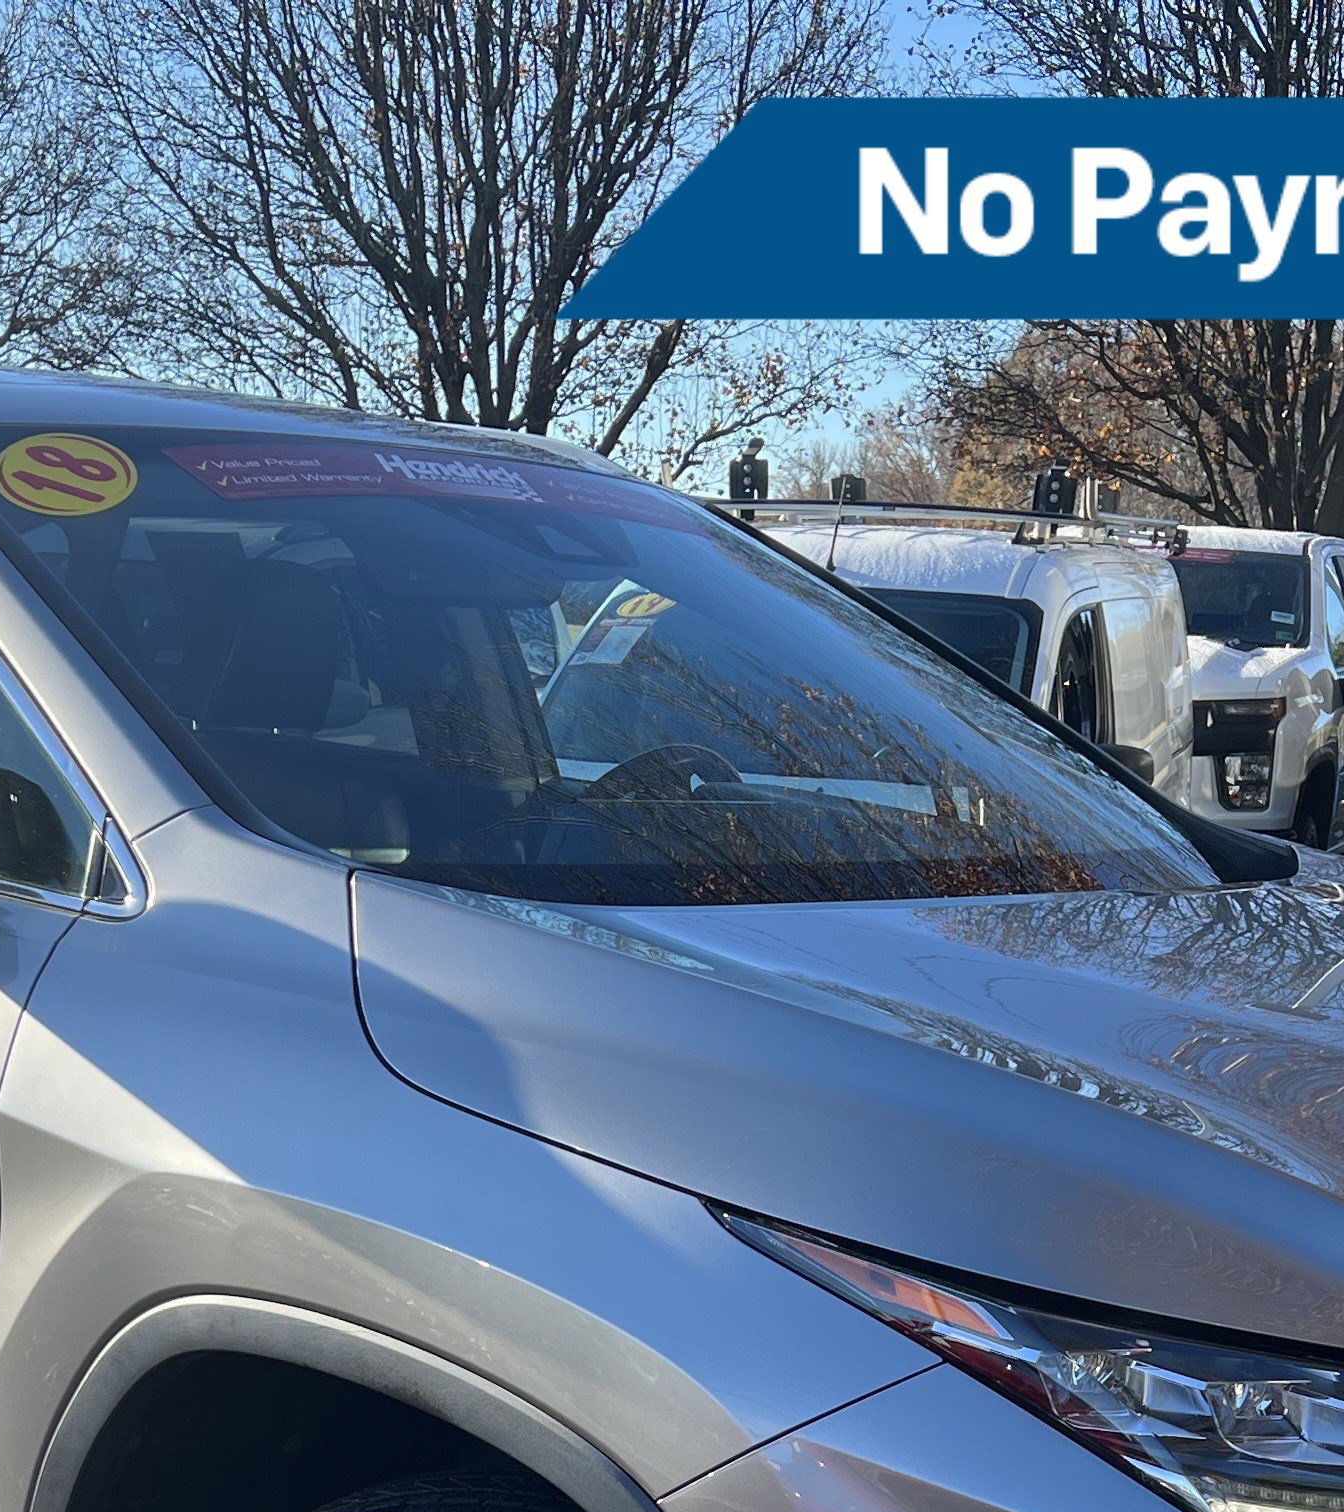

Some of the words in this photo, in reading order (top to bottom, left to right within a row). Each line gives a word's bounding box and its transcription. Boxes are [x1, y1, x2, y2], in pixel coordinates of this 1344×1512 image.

[11, 444, 118, 504] 18
[231, 472, 298, 485] Limited
[300, 472, 384, 485] Warranty
[374, 453, 528, 490] Hendrick
